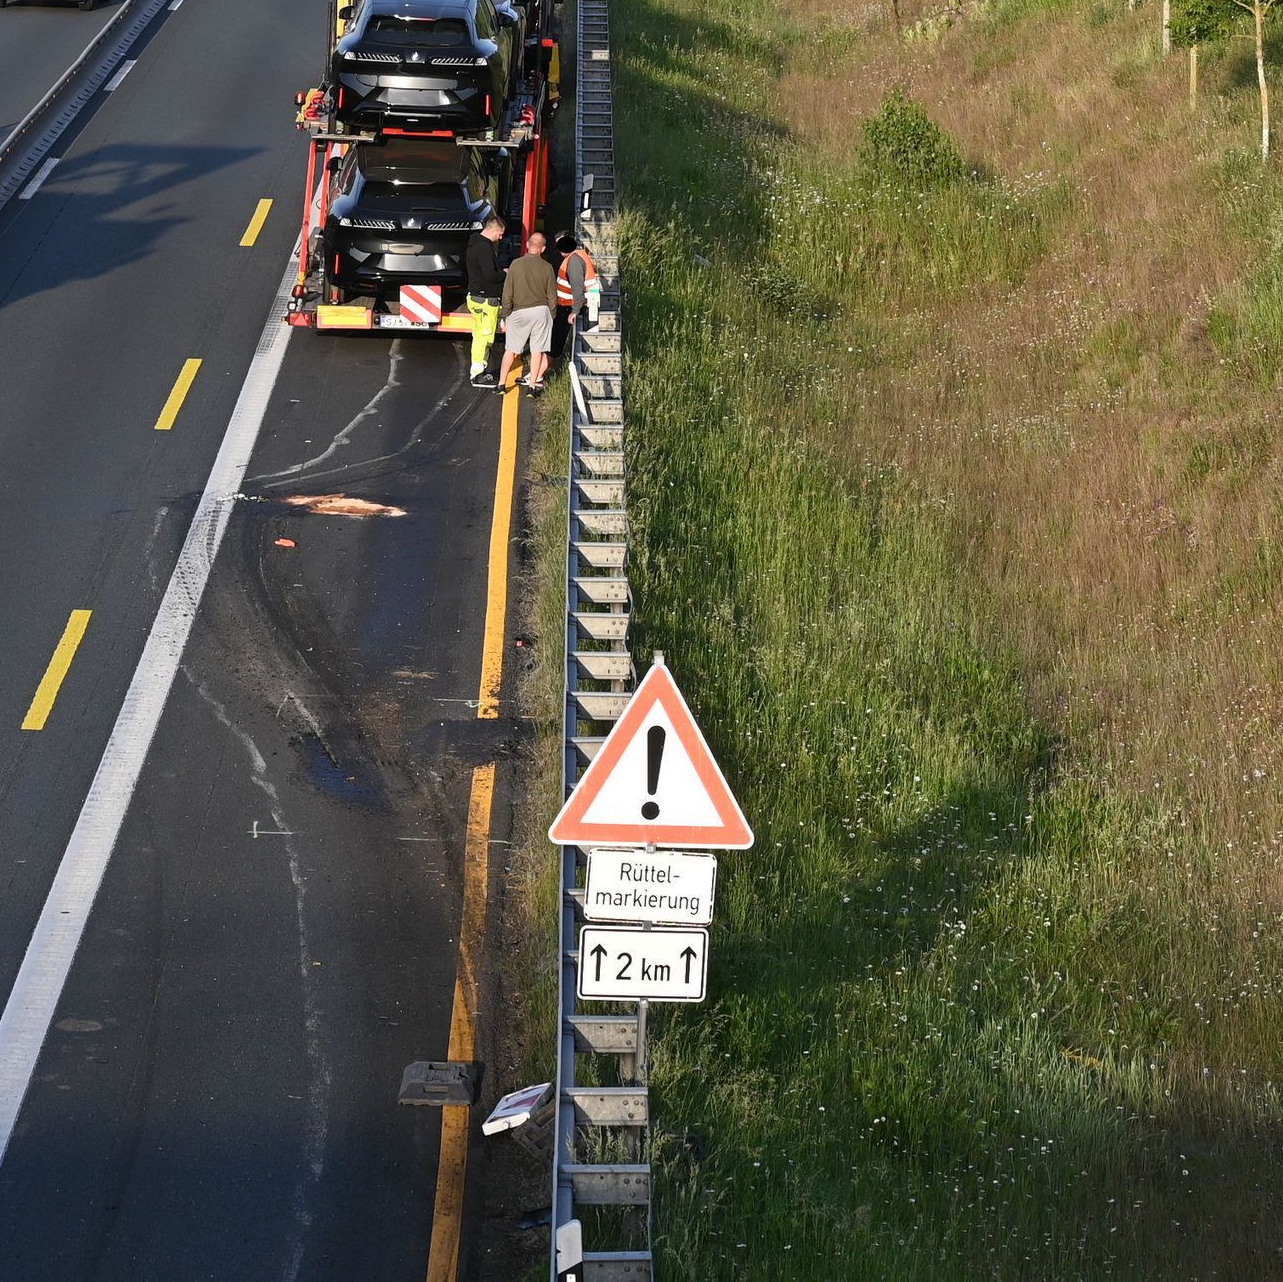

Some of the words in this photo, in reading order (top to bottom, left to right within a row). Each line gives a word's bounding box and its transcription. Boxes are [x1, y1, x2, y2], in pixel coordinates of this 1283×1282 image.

[620, 862, 680, 883] Rüttel-
[595, 889, 700, 915] markierung
[616, 952, 632, 980] 2
[641, 958, 671, 981] km
